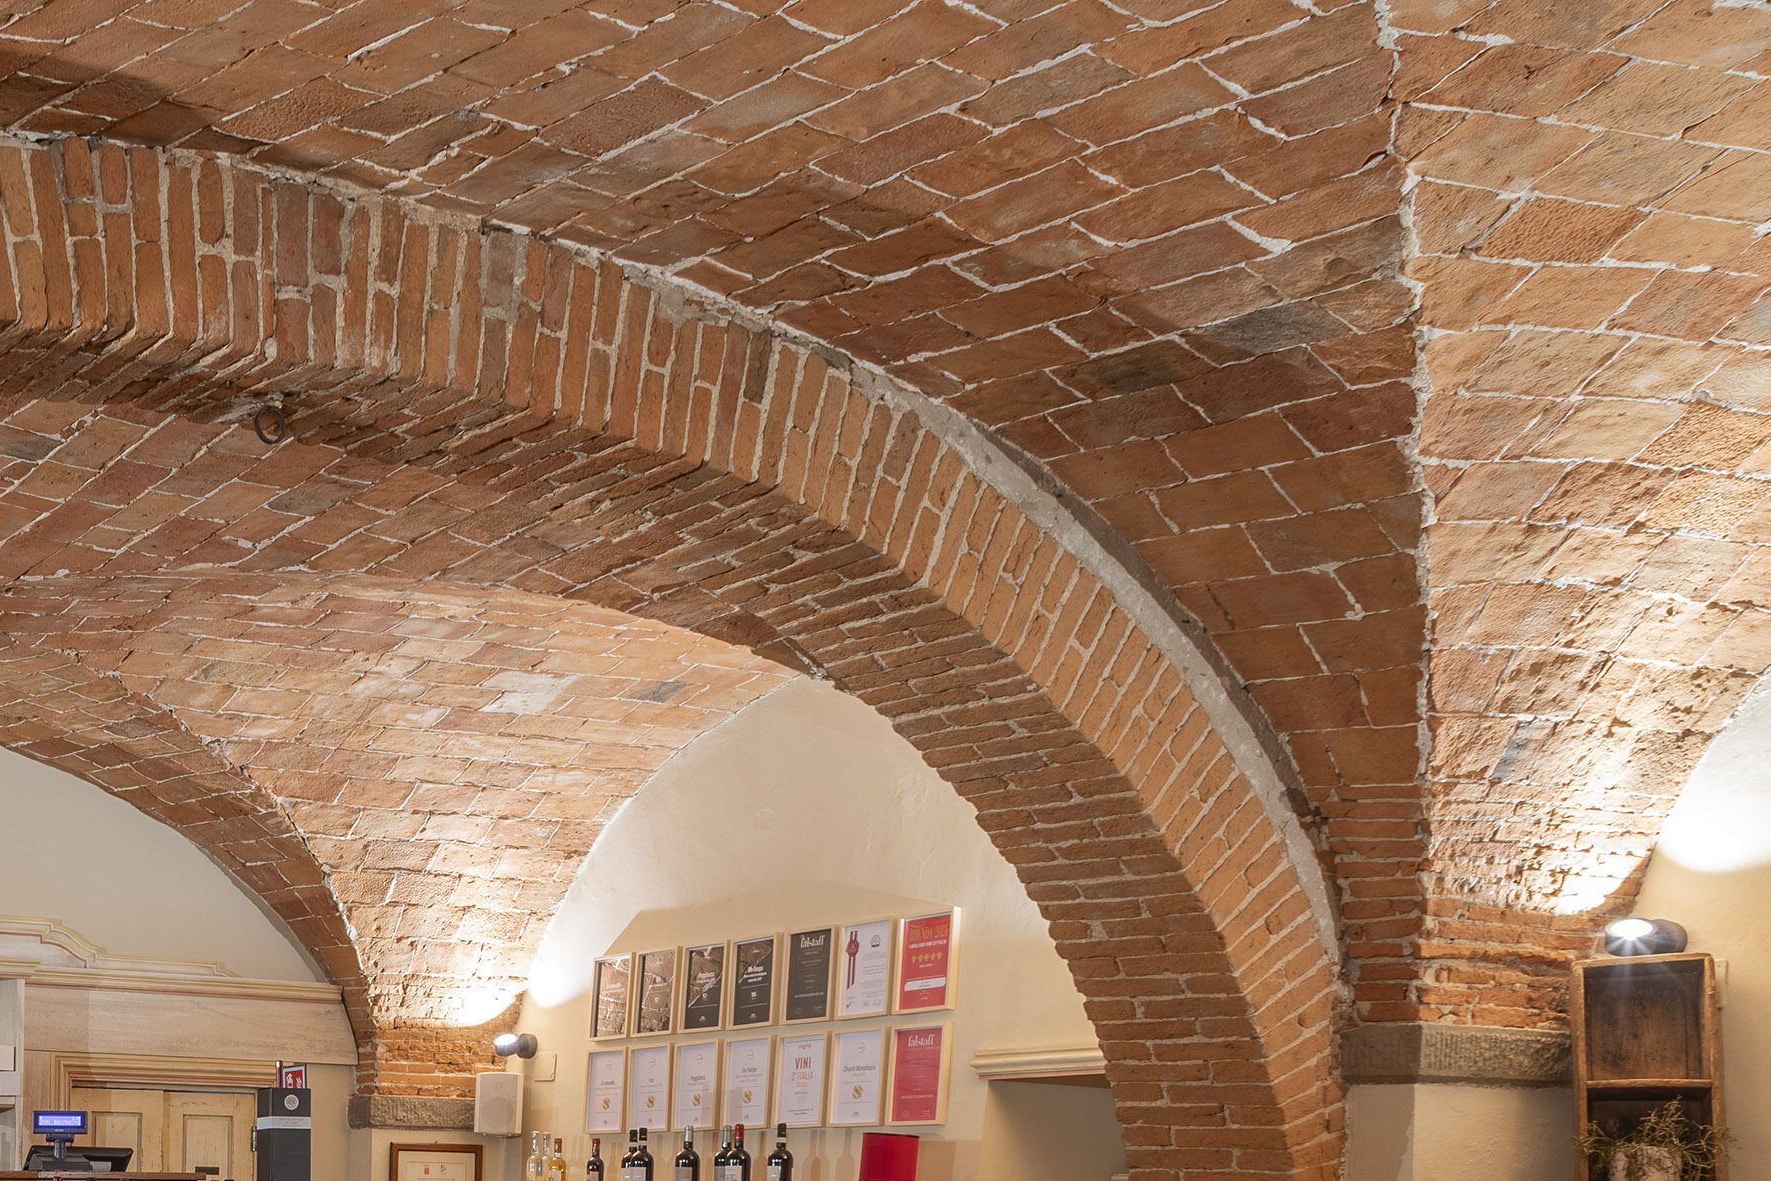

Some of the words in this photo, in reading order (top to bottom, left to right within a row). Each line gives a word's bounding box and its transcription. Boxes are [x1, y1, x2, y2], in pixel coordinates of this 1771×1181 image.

[800, 934, 825, 948] falstaff
[908, 1034, 935, 1047] falstaff
[795, 1056, 812, 1070] VINI
[791, 1071, 814, 1081] D'ITALIA
